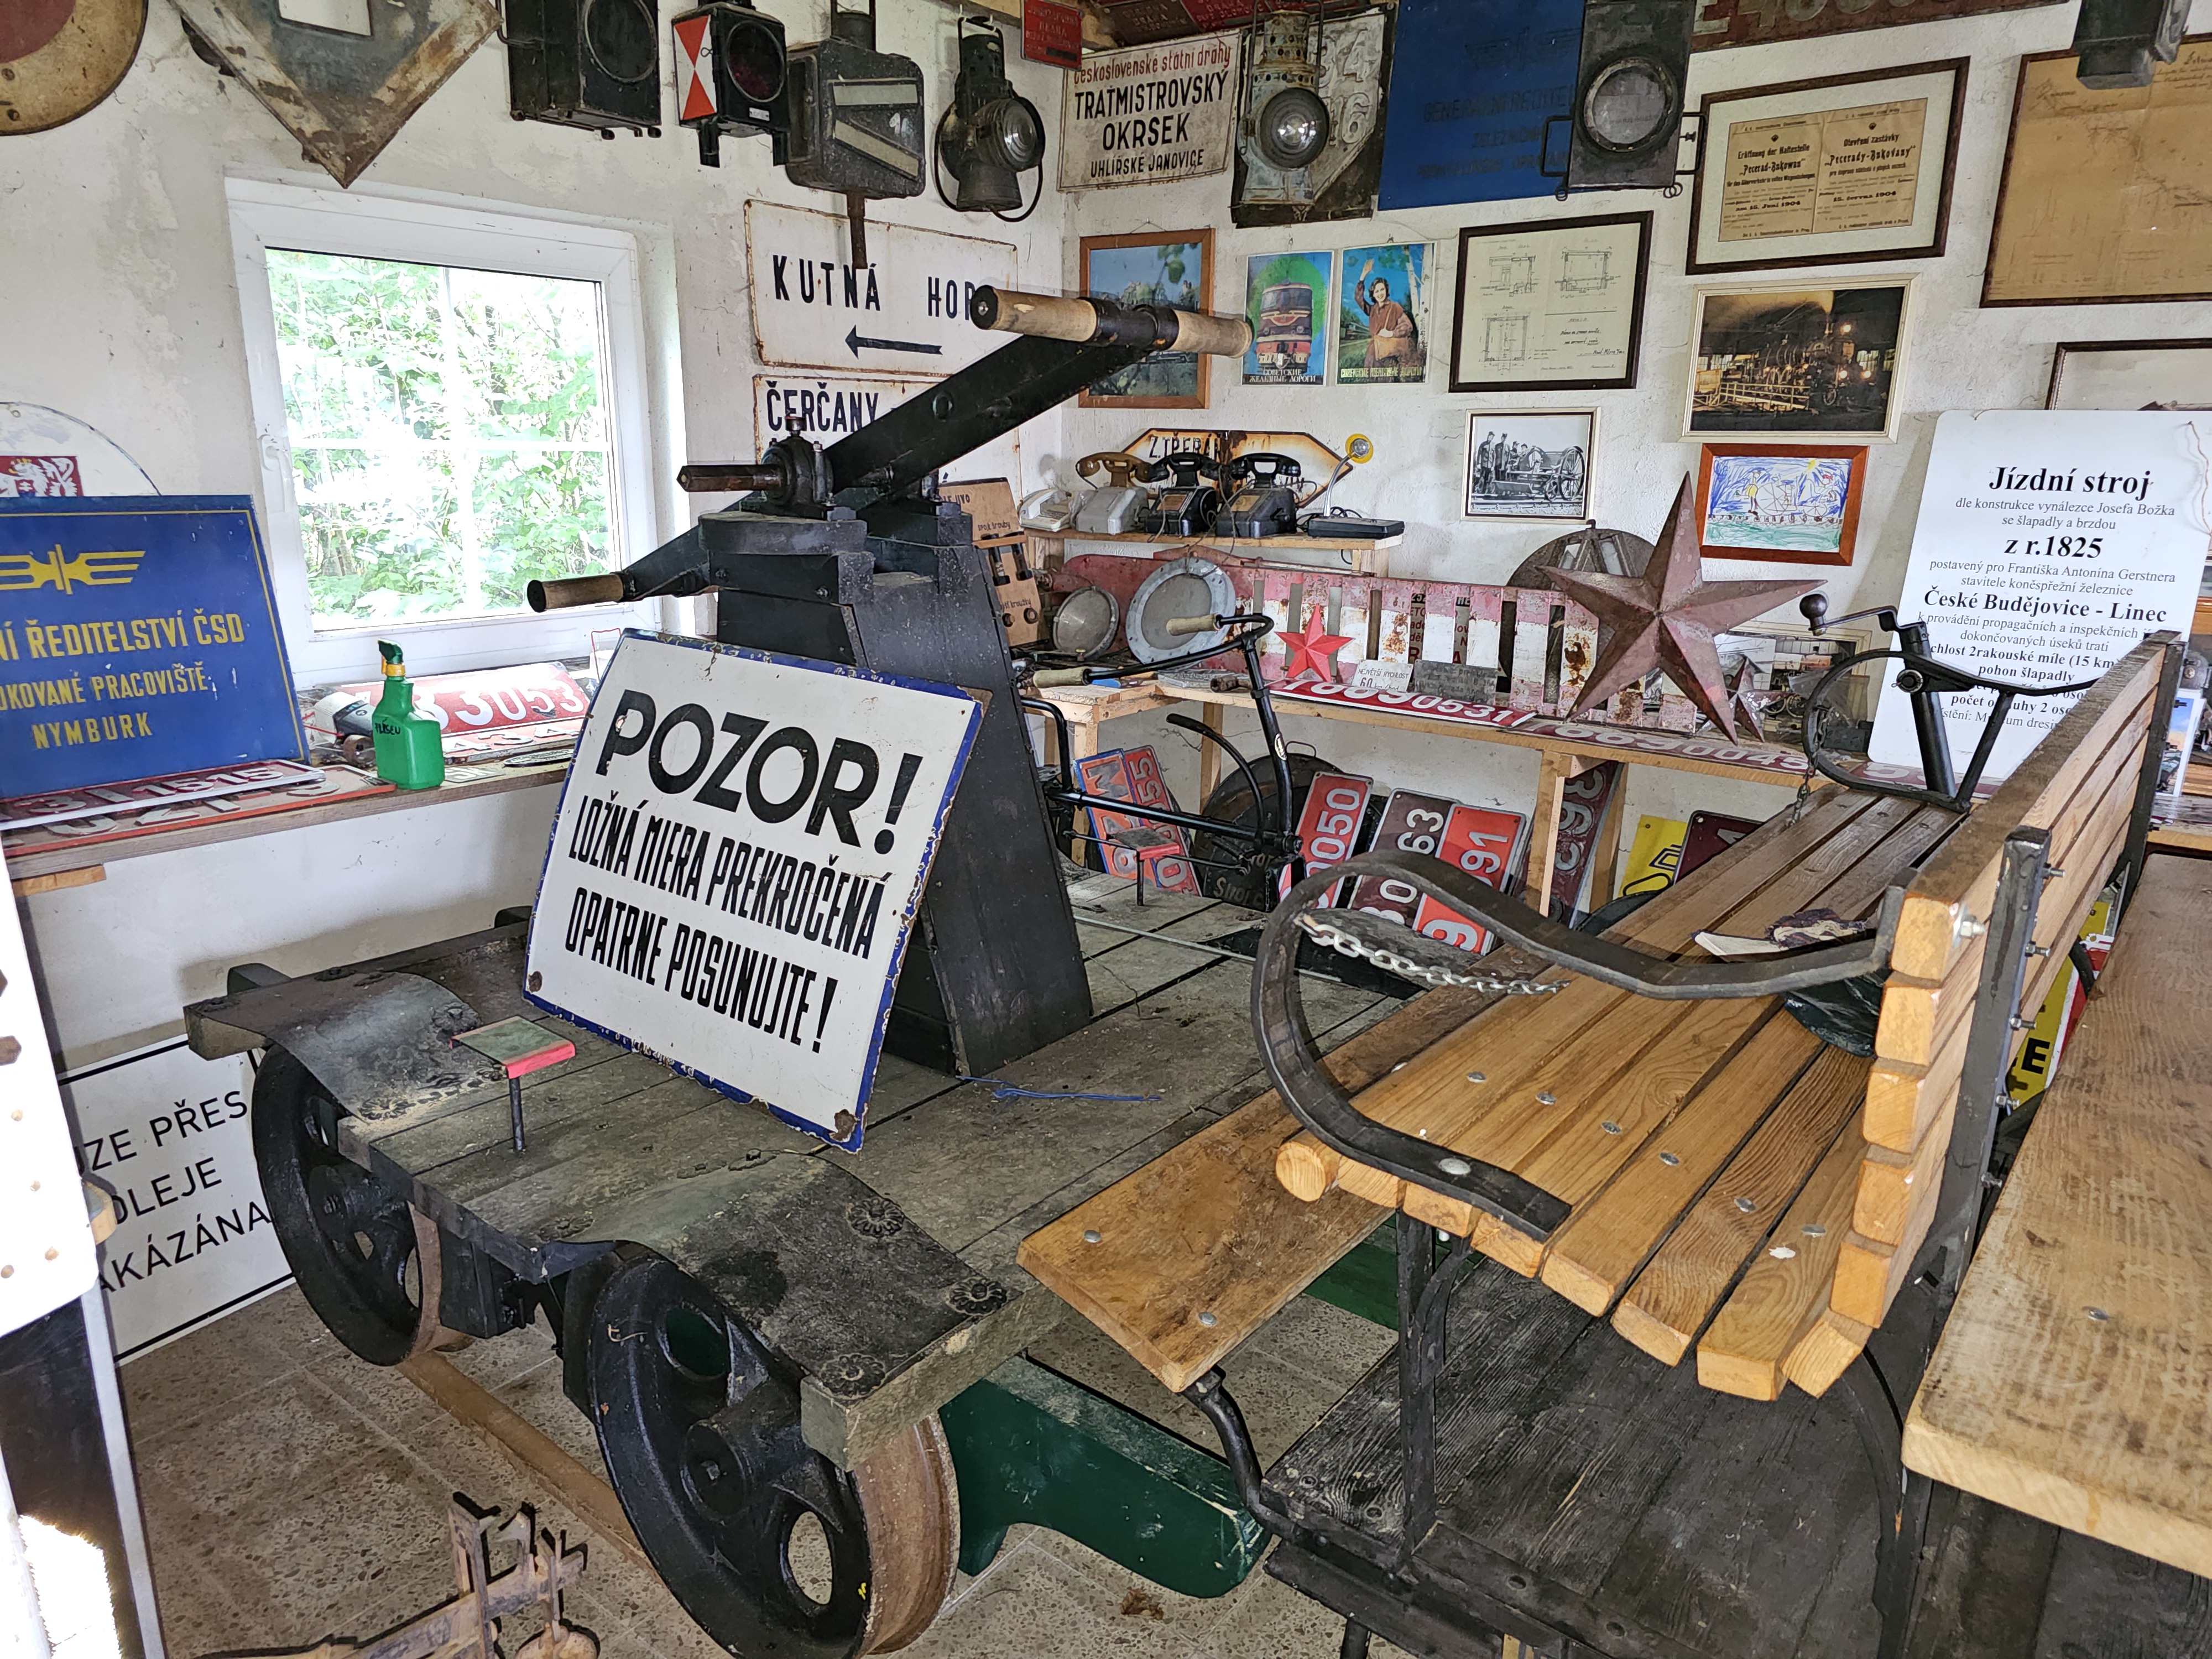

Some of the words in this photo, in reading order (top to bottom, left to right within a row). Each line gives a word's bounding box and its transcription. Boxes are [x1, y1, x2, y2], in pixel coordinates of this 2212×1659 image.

[1074, 69, 1229, 120] TRAŤMISTROVSKÝ
[1103, 112, 1190, 150] OKRSEK
[1091, 152, 1145, 178] UHLÍŘSKÉ
[1148, 149, 1204, 172] JANOVICE
[773, 254, 881, 312] KUTNÁ
[927, 276, 977, 321] HOR
[766, 380, 879, 432] ČERČANY
[1989, 466, 2078, 492] Jízdní
[2083, 470, 2151, 502] stroj
[1955, 497, 1972, 508] dle
[1975, 498, 2034, 510] konstrukce
[2038, 500, 2094, 513] vynálezce
[2096, 502, 2133, 514] Josefa
[2137, 504, 2175, 516] Božka
[2002, 517, 2014, 525] se
[2017, 515, 2064, 529] šlapadly
[2076, 518, 2116, 529] brzdou
[2004, 539, 2018, 554] z
[2024, 535, 2104, 559] r.1825
[1929, 560, 1984, 573] postavený
[1985, 564, 2005, 574] pro
[2008, 562, 2058, 576] Františka
[2060, 566, 2115, 579] Antonína
[2118, 568, 2176, 582] Gerstnera
[1961, 576, 2006, 588] stavitele
[2008, 577, 2077, 593] koněspřežní
[2078, 582, 2133, 596] železnice
[1924, 585, 1979, 608] České
[1983, 593, 2090, 618] Budějovice
[2108, 602, 2167, 622] Linec
[25, 609, 188, 659] ŘEDITELSTVÍ
[195, 607, 244, 645] ČSD
[1917, 611, 1926, 621] k
[1926, 613, 1981, 625] provádění
[1982, 618, 2056, 632] propagačních
[2059, 624, 2066, 633] a
[2069, 623, 2138, 638] inspekčních
[1960, 630, 2046, 648] dokončovaných
[2049, 637, 2082, 650] úseků
[2086, 641, 2110, 652] trati
[1969, 645, 2034, 662] 2rakouské
[2038, 653, 2065, 665] míle
[2069, 654, 2089, 668] (15
[91, 661, 207, 701] PRACOVIŠTĚ
[1358, 667, 1383, 676] NEJVĚTŠÍ
[1384, 669, 1409, 679] RYCHLOST
[1978, 664, 2016, 678] pohon
[2021, 666, 2075, 685] šlapadly
[1950, 694, 1985, 706] počet
[2040, 702, 2048, 713] 2
[32, 712, 153, 749] NYMBURK
[568, 790, 649, 874] LOŽNÁ
[633, 815, 711, 901] MIERA
[706, 837, 893, 959] PREKROČENÁ
[565, 886, 667, 986] OPATRNE
[150, 1091, 248, 1147] PŘES
